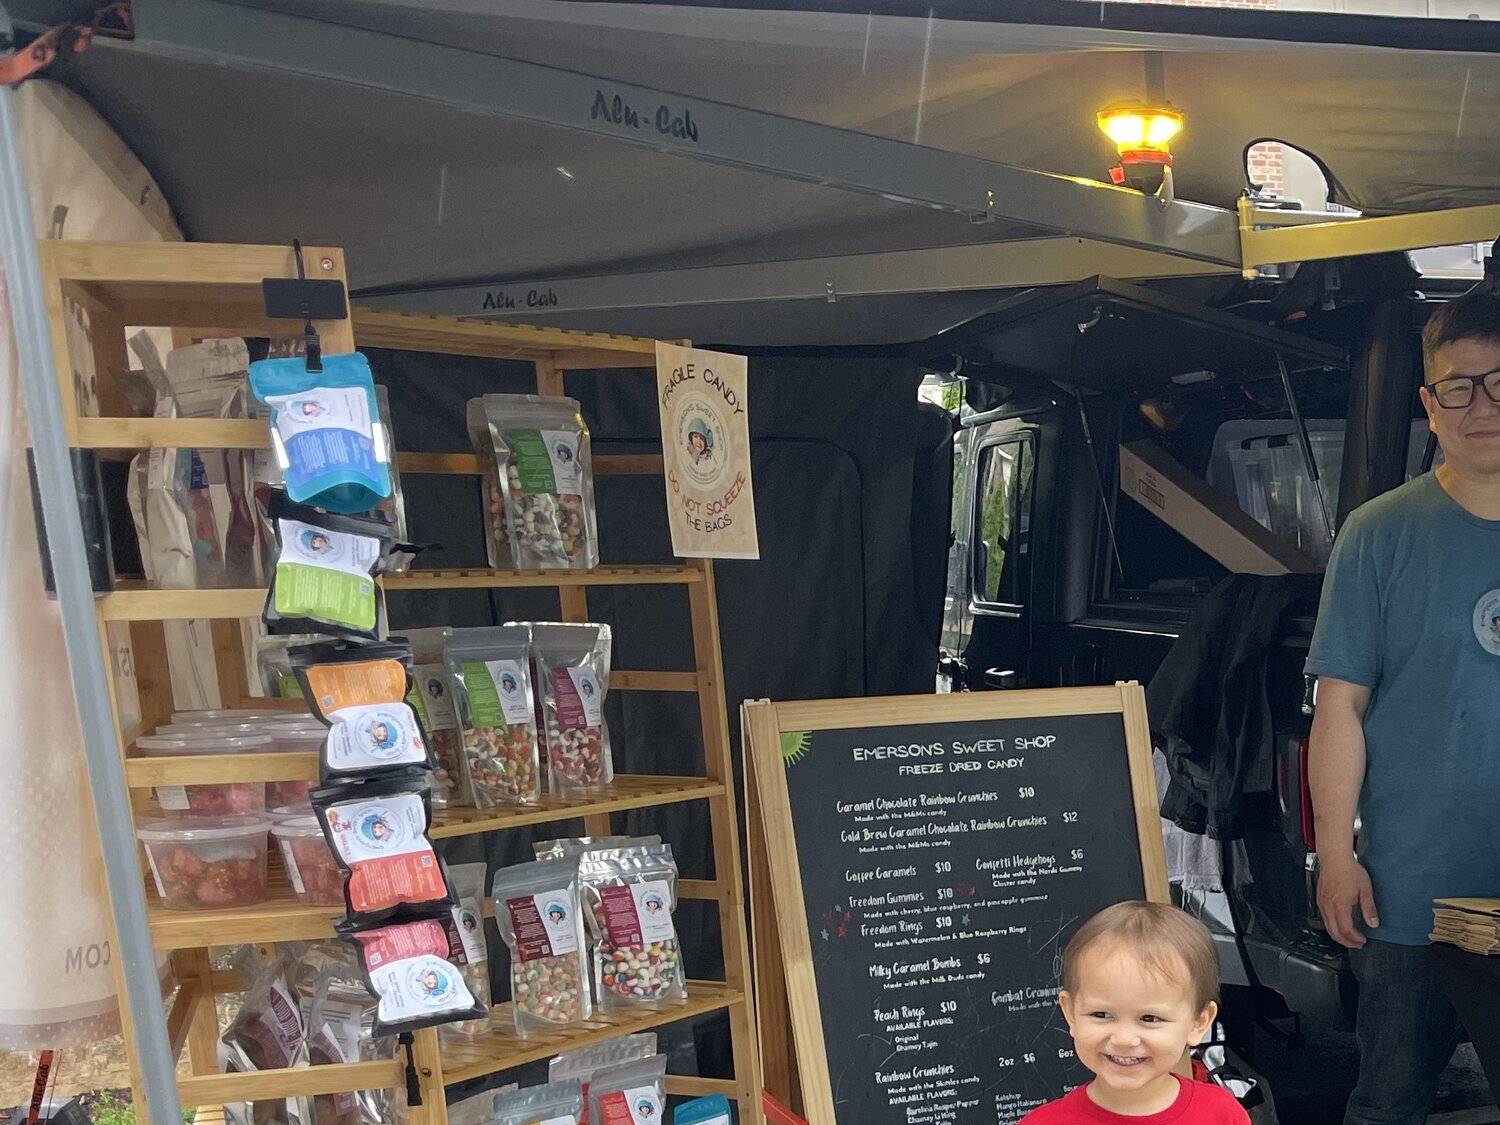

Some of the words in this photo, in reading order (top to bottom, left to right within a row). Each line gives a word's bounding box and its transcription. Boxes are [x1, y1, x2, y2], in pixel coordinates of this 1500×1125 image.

[662, 364, 695, 410] FRAGILE
[704, 368, 744, 415] CANDY
[682, 495, 701, 514] NOT
[706, 471, 746, 516] SQUEEZE
[685, 512, 702, 531] THE
[705, 513, 733, 533] BAGS
[952, 739, 1005, 755] SWEET
[1014, 735, 1057, 750] SHOP
[899, 763, 944, 775] FREEZE
[987, 757, 1025, 769] CANDY
[836, 800, 874, 813] Caramel
[876, 797, 917, 810] Chocolate
[920, 794, 955, 806] Rainbow
[957, 791, 998, 803] Crunchies
[1018, 787, 1035, 798] $10
[927, 808, 947, 816] candy
[841, 830, 860, 842] Cold
[862, 828, 887, 841] Brew
[889, 825, 926, 838] Caramel
[928, 821, 969, 835] Chocolate
[970, 819, 1005, 831] Rainbow
[1007, 815, 1047, 828] Crunchies
[1063, 811, 1078, 823] $12
[859, 845, 878, 853] Made
[931, 838, 951, 847] candy
[976, 858, 1010, 870] Confetti
[1013, 854, 1056, 869] Hedgehogs
[1071, 848, 1084, 860] $6
[845, 870, 874, 883] Coffee
[876, 865, 917, 880] Caramels
[935, 861, 952, 873] $10
[849, 896, 885, 908] Freedom
[886, 892, 925, 904] Gummies
[937, 888, 953, 900] $10
[861, 924, 897, 937] Freedom
[899, 920, 923, 935] Rings
[936, 916, 952, 929] $10
[869, 965, 892, 980] Milky
[893, 960, 930, 975] Caramel
[932, 956, 961, 970] Bombs
[977, 953, 991, 965] $6
[991, 989, 1023, 1006] Combat
[873, 1009, 899, 1021] Peach
[901, 1006, 926, 1020] Rings
[940, 1000, 957, 1013] $10
[886, 1021, 922, 1032] AVAILABLE
[895, 1034, 919, 1043] Original
[998, 1057, 1014, 1067] 2oz
[1023, 1053, 1036, 1063] $6
[875, 1070, 911, 1083] Rainbow
[913, 1064, 954, 1078] Crunchies
[889, 1093, 924, 1105] AVAILABLE
